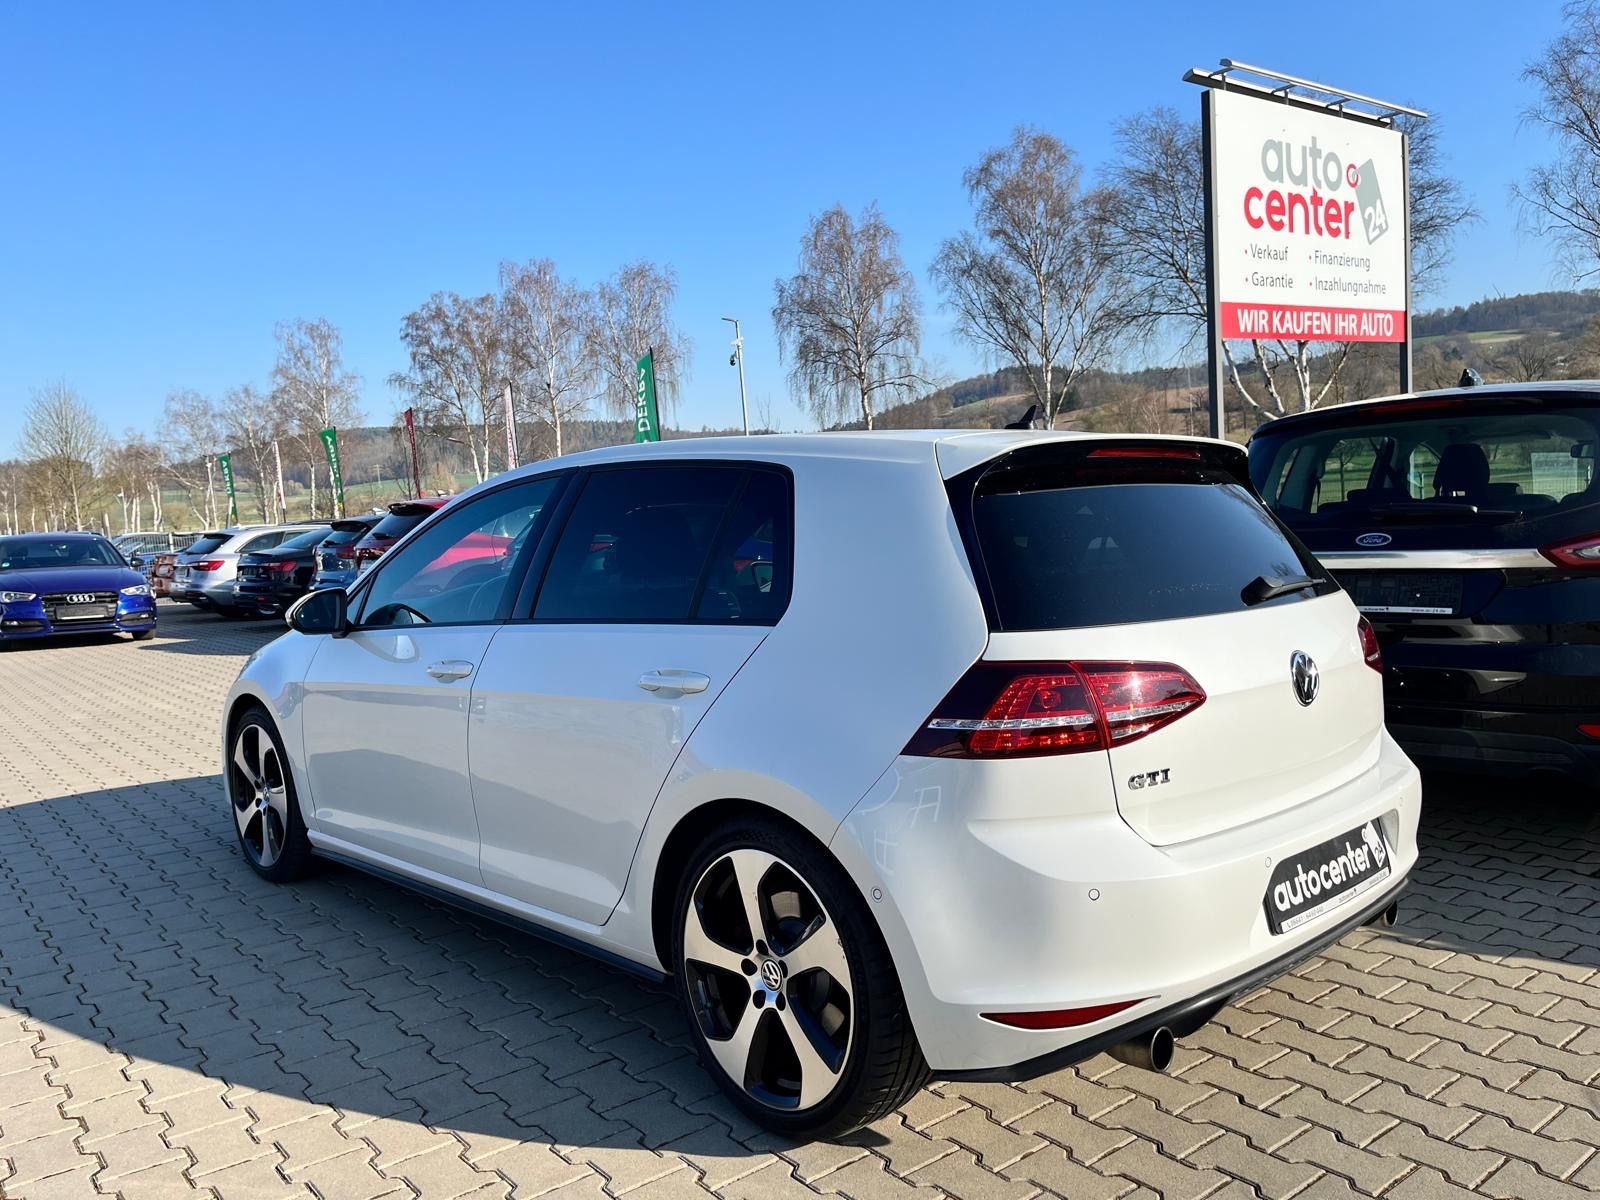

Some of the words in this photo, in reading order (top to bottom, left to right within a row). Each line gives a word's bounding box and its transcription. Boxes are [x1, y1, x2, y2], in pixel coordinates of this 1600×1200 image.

[1261, 136, 1343, 192] auto
[1243, 186, 1355, 240] center
[1364, 198, 1388, 240] 24
[1250, 243, 1289, 262] Verkauf
[1314, 250, 1371, 272] Finanzierung
[1251, 272, 1293, 289] Garantie
[1315, 275, 1386, 296] Inzahlungnahme
[1237, 308, 1270, 333] WIR
[1272, 310, 1331, 336] KAUFEN
[1334, 313, 1357, 336] IHR
[1360, 312, 1394, 337] AUTO
[1128, 768, 1170, 790] GTI
[1274, 841, 1370, 912] autocenter
